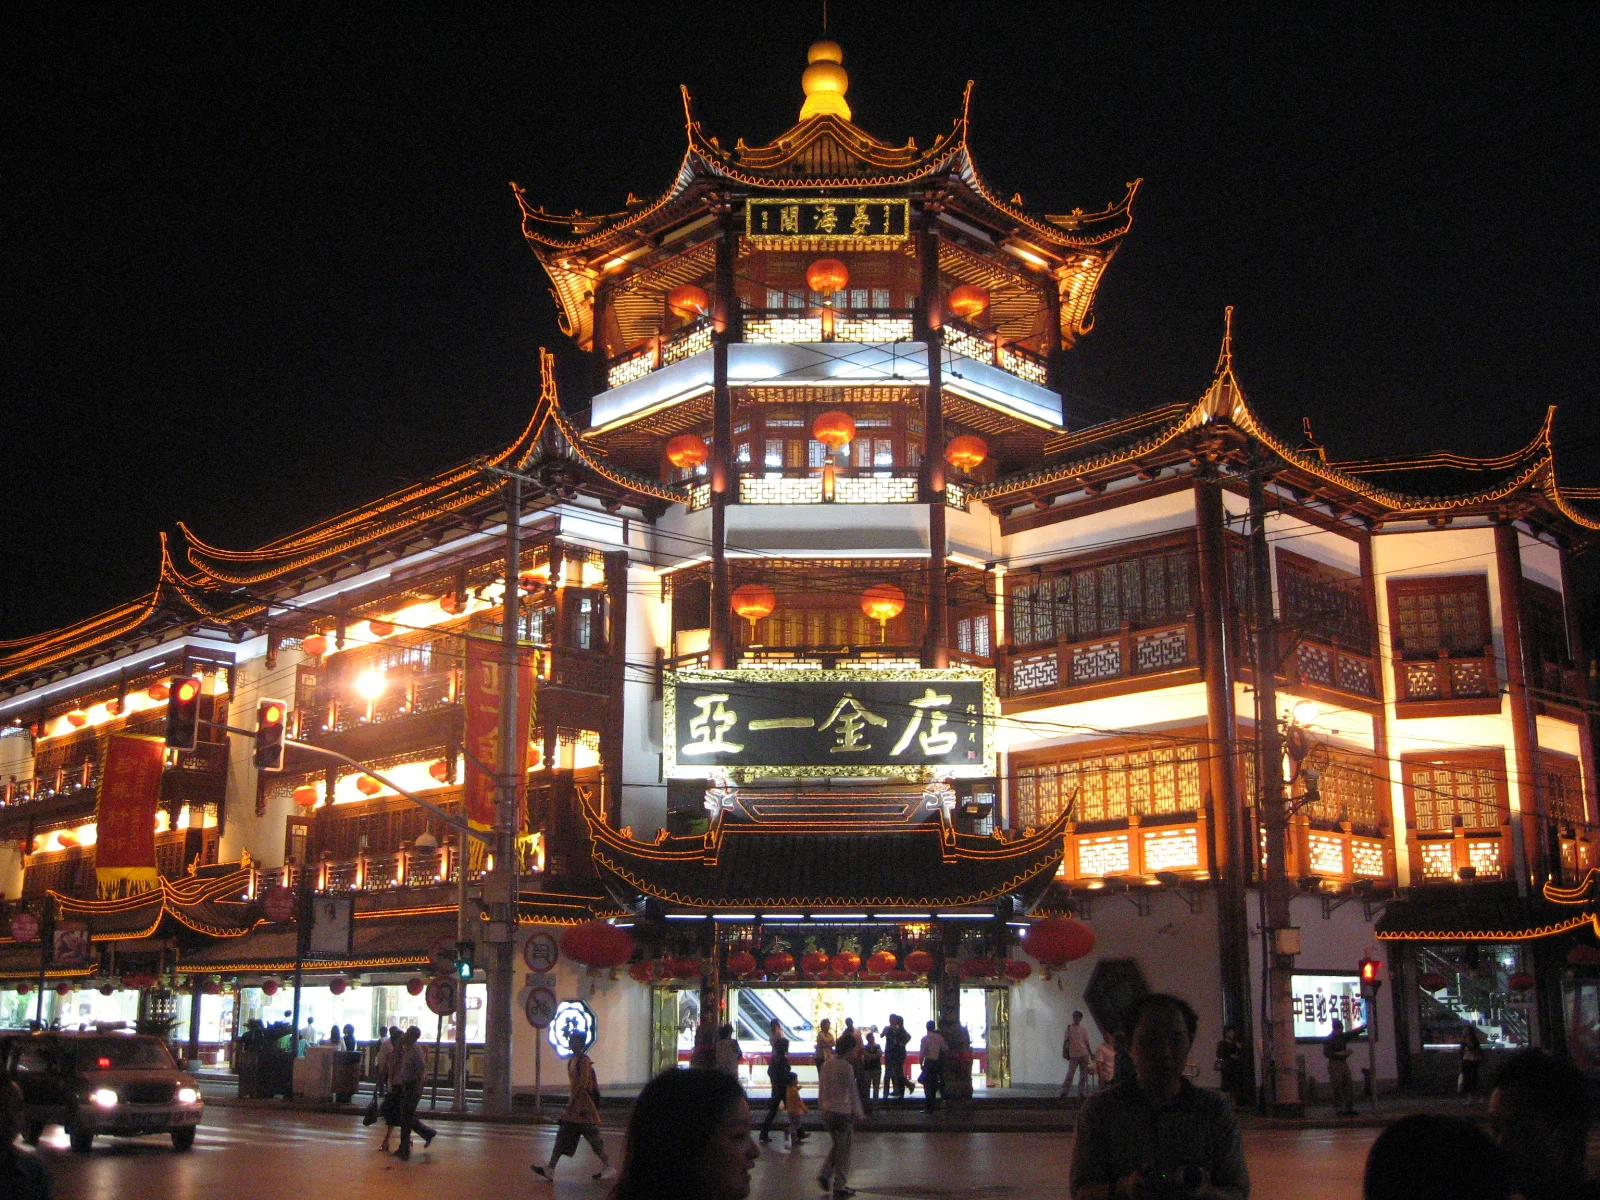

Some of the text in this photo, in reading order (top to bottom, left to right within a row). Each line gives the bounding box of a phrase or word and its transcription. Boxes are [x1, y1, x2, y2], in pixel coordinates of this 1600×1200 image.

[1291, 993, 1363, 1025] 中国驰名商标
